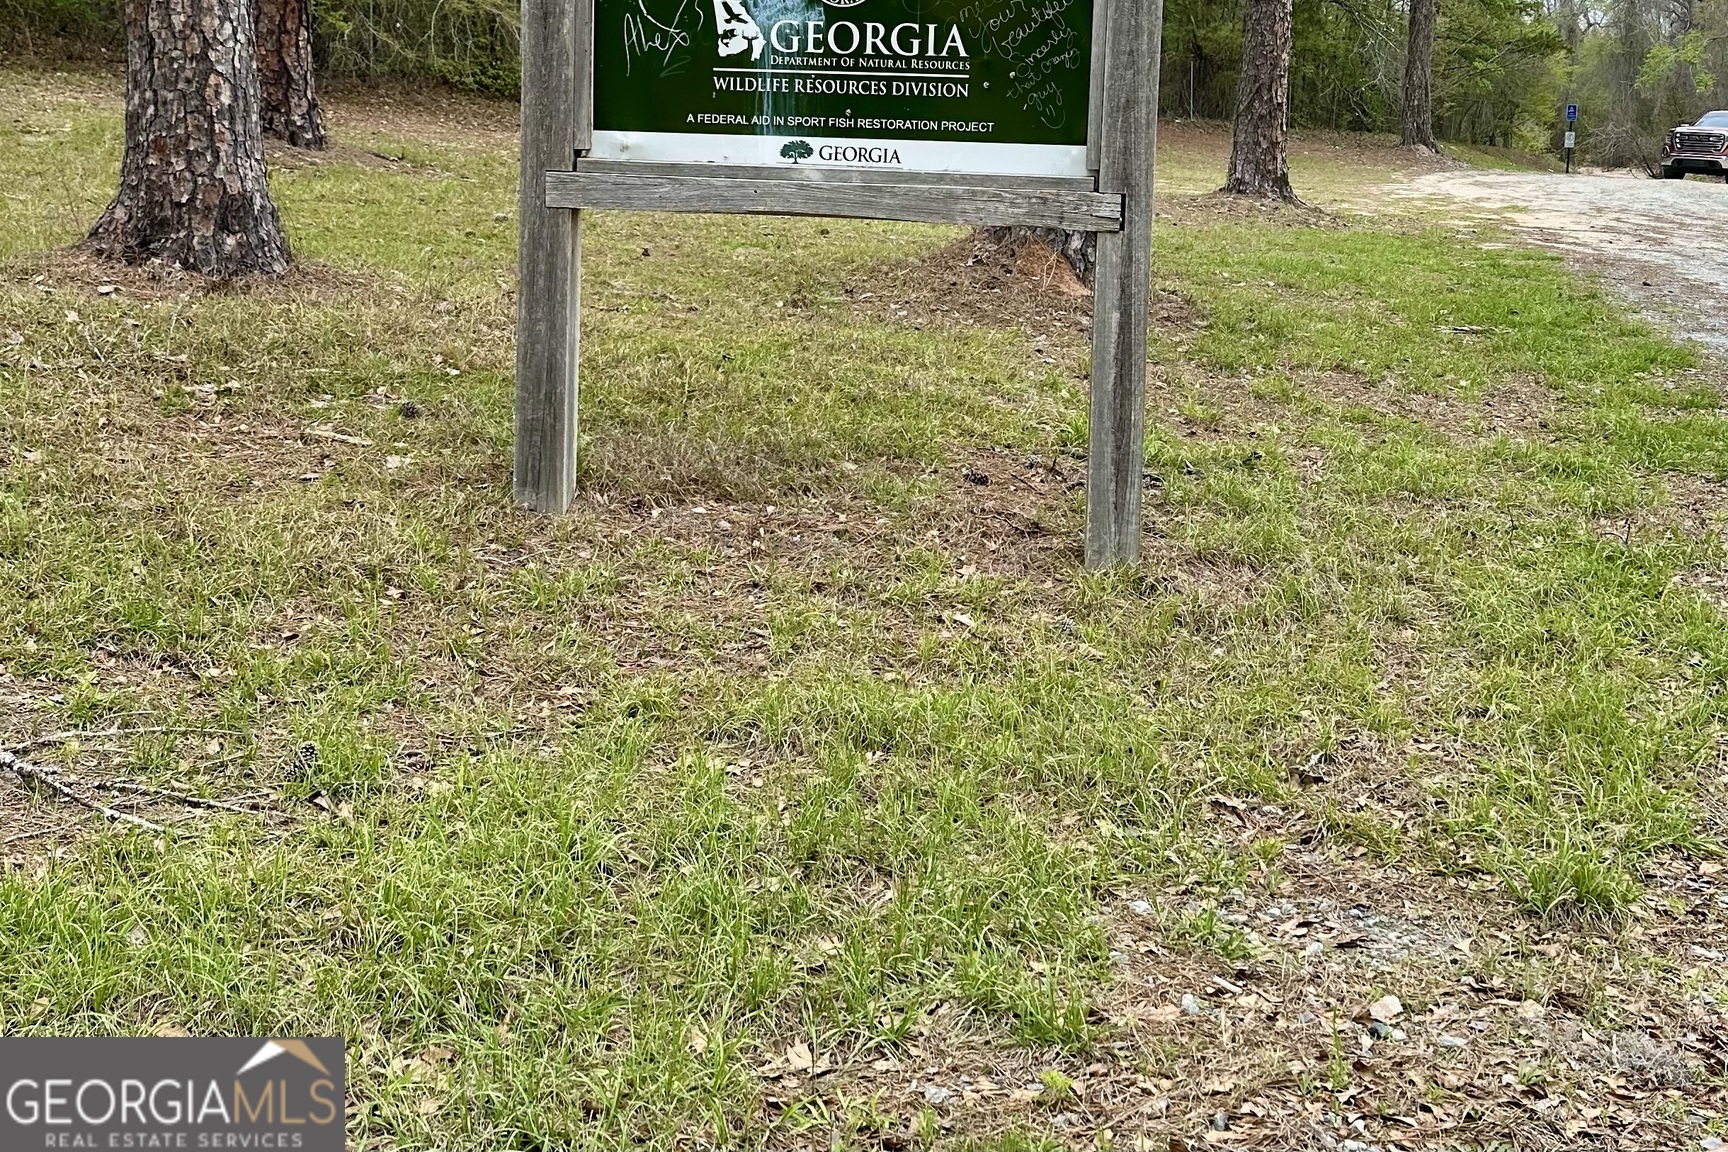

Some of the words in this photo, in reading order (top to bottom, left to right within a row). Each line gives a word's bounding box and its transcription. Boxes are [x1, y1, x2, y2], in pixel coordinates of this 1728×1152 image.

[770, 20, 969, 57] GEORGIA
[770, 55, 838, 67] DEPARTMENT
[858, 58, 907, 69] NATURAL
[911, 59, 970, 70] RESOURCES
[713, 77, 789, 92] WILDLIFE
[794, 78, 887, 95] RESOURCES
[892, 81, 969, 97] DIVISION
[686, 113, 695, 123] A
[697, 114, 749, 125] FEDERAL
[751, 115, 770, 125] AID
[773, 116, 785, 126] IN
[787, 116, 826, 127] SPORT
[828, 118, 855, 128] FISH
[857, 118, 938, 131] RESTORATION
[941, 121, 995, 133] PROJECT
[819, 145, 902, 164] GEORGIA
